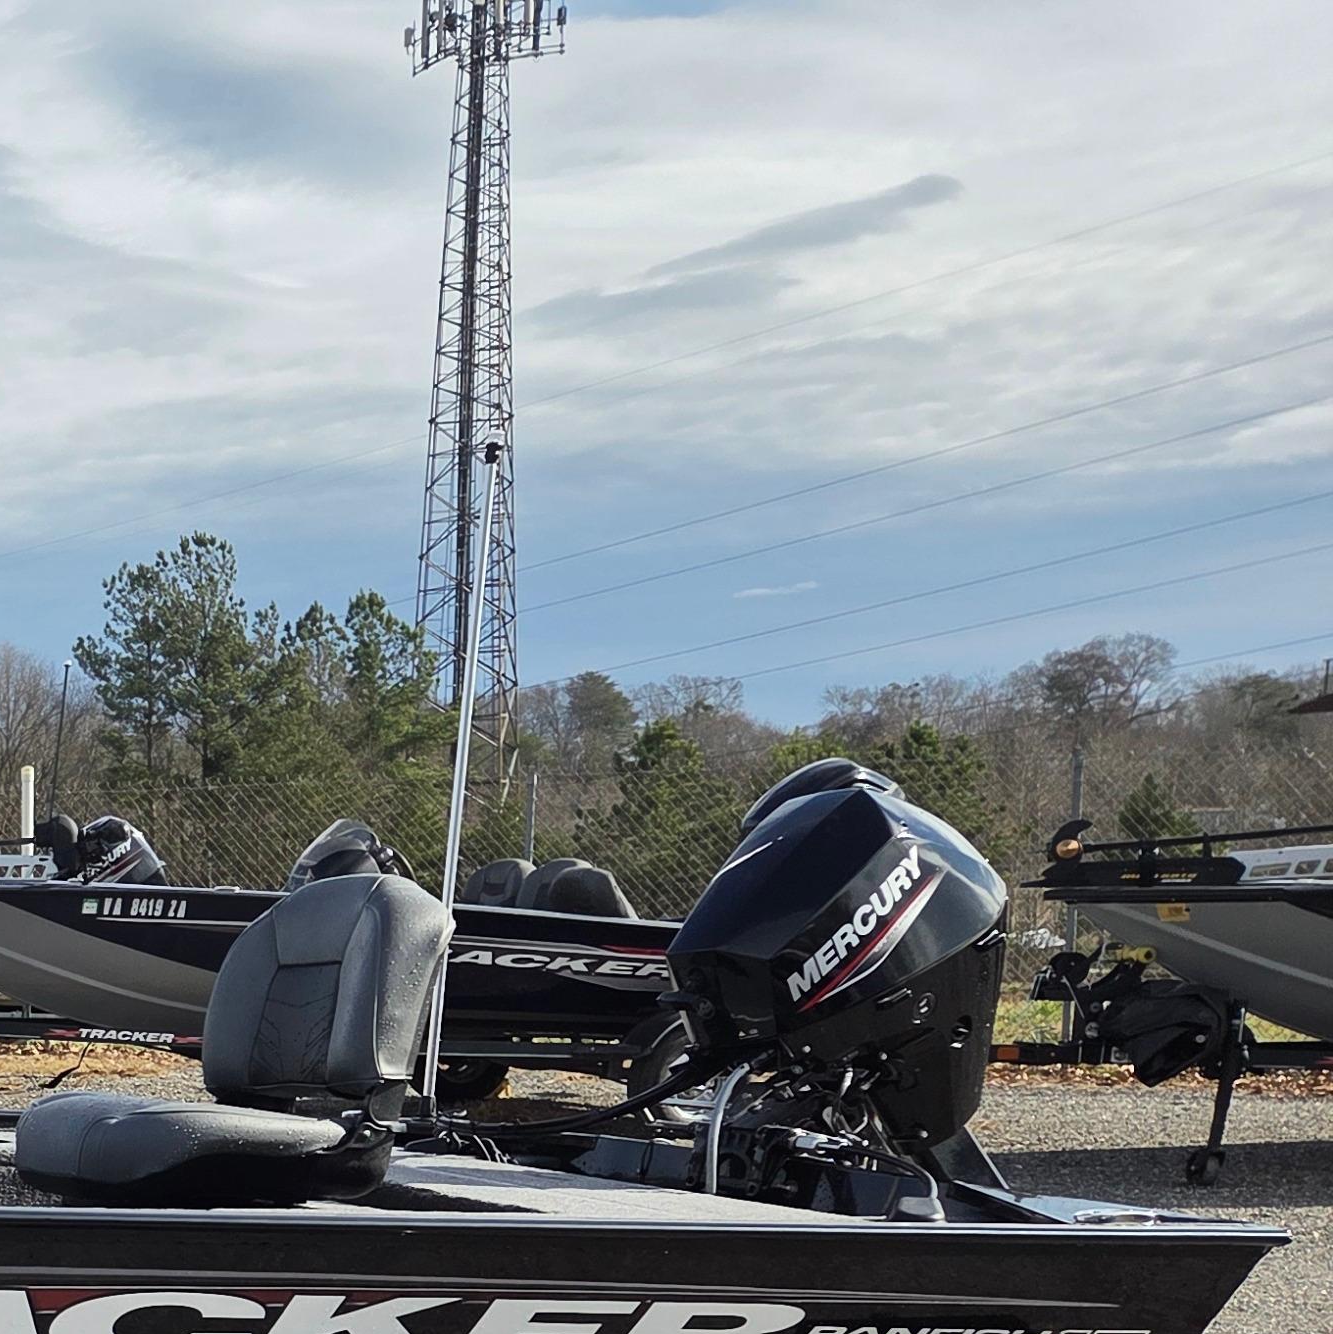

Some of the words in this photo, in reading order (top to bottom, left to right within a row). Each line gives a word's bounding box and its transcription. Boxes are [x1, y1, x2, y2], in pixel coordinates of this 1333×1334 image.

[787, 845, 921, 1002] MERCURY
[437, 949, 670, 978] ACKER
[78, 1028, 175, 1043] TRACKER
